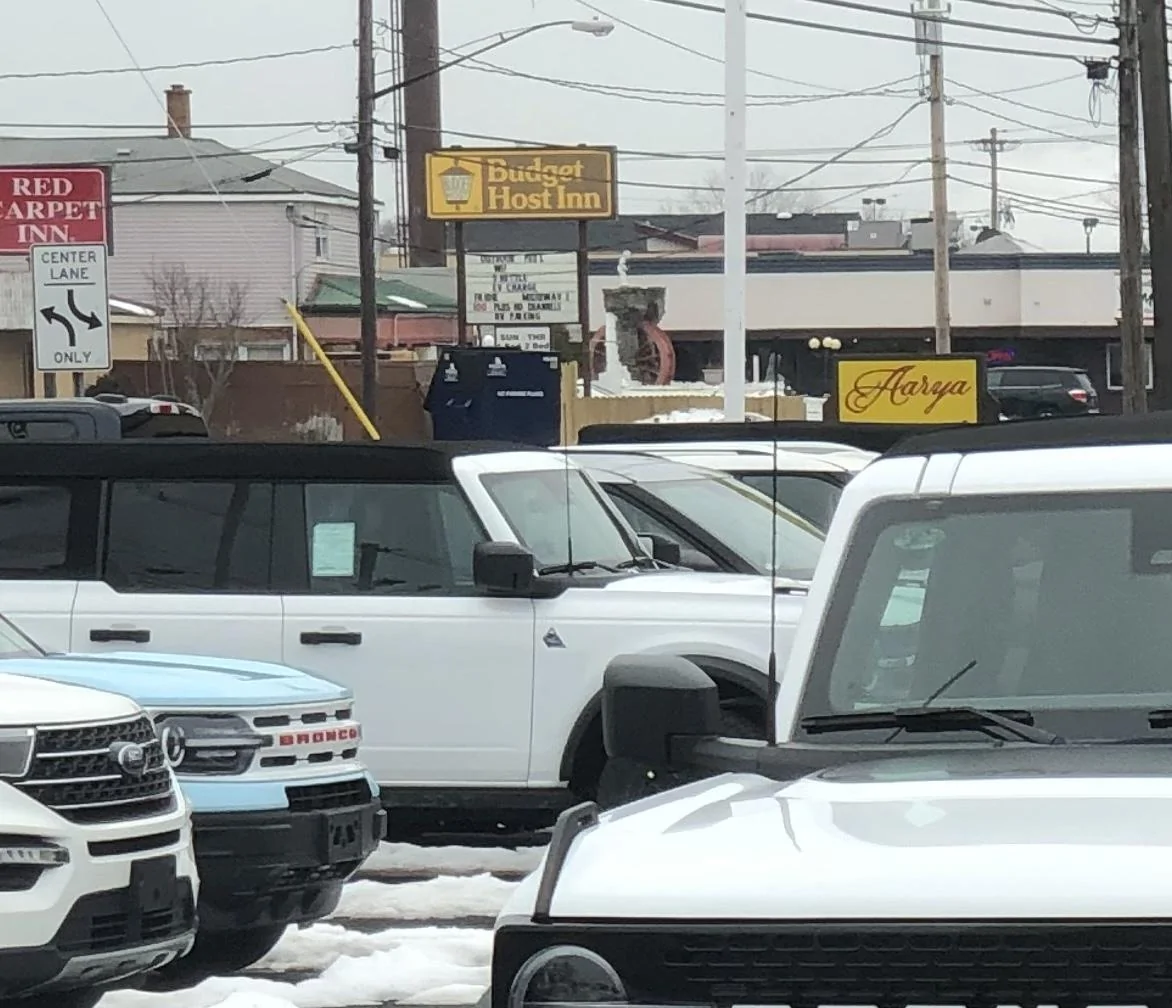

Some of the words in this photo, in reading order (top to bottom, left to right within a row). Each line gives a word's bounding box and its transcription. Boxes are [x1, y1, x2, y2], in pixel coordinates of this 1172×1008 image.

[487, 157, 585, 187] Budget
[12, 177, 74, 196] RED
[487, 186, 553, 210] Host
[556, 185, 602, 210] Inn
[0, 200, 101, 220] ARPET
[41, 251, 97, 264] CENTER
[50, 267, 89, 280] LANE
[54, 351, 92, 363] ONLY
[845, 365, 971, 414] Aarya
[279, 727, 358, 747] BRONCO
